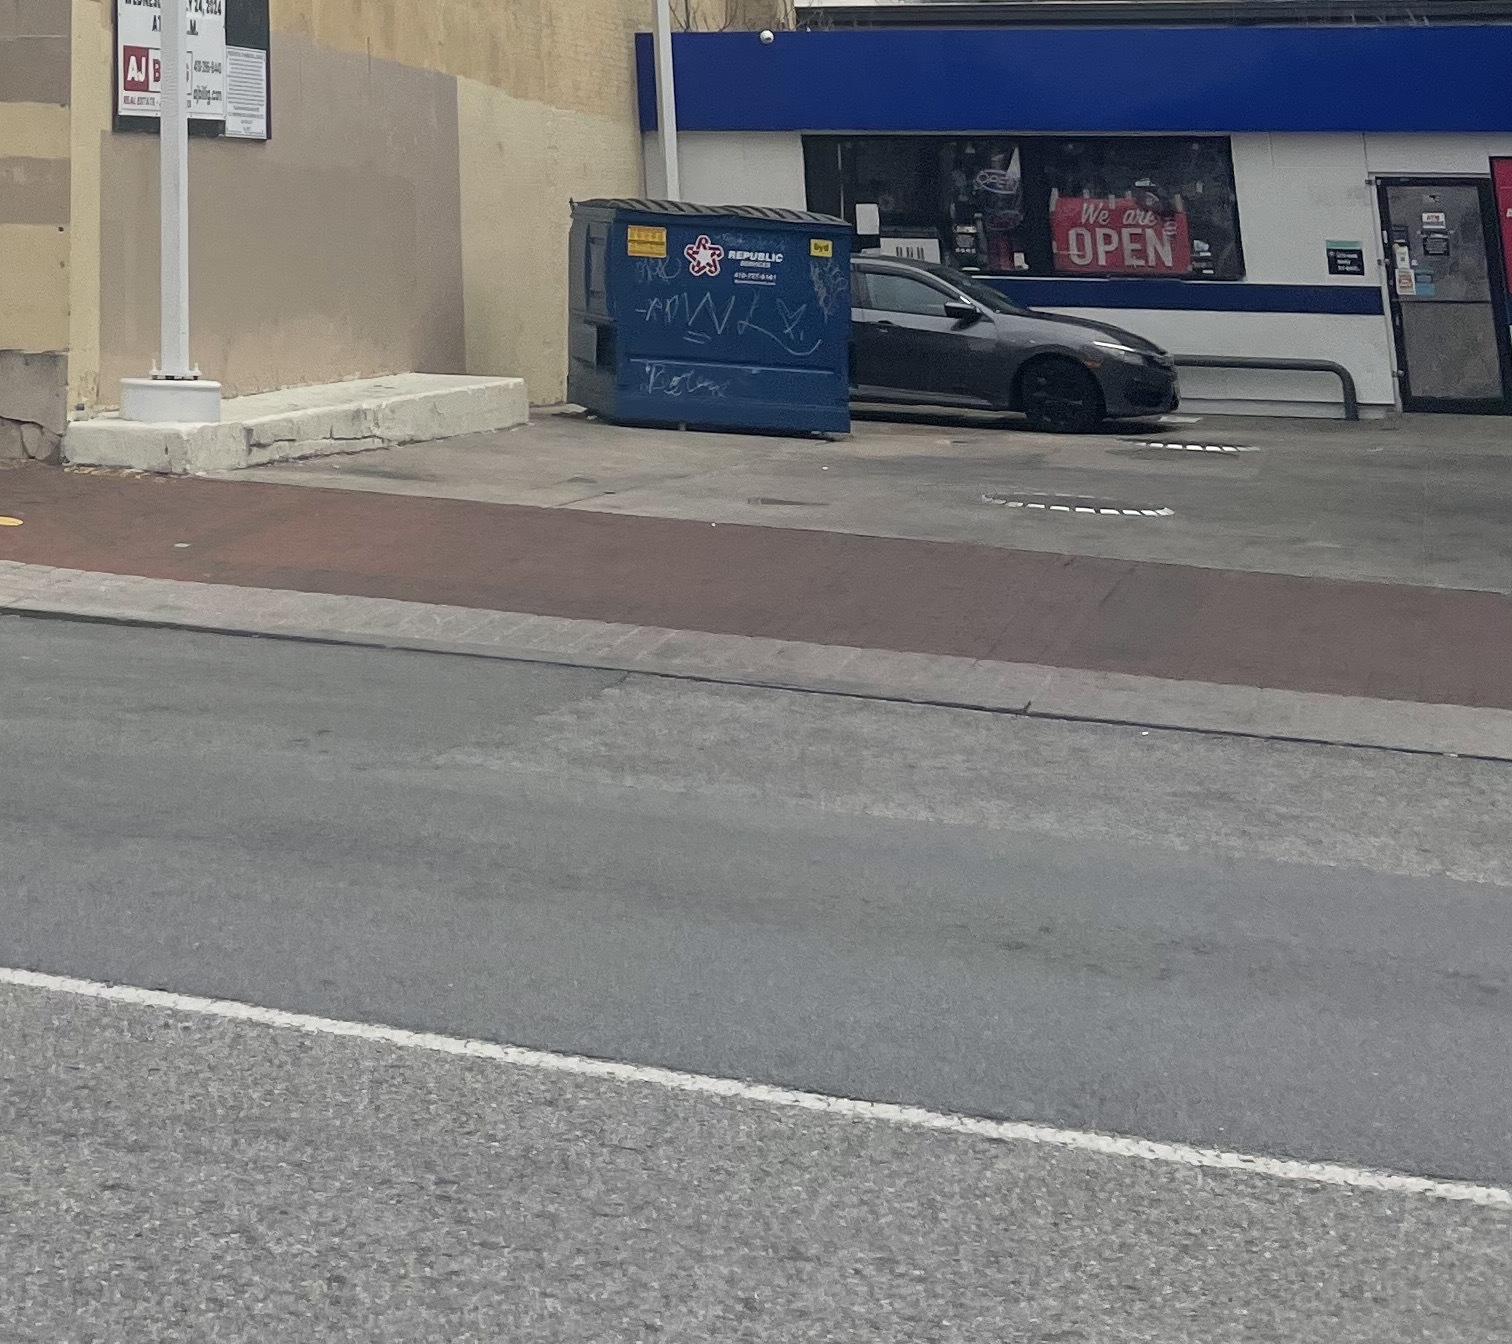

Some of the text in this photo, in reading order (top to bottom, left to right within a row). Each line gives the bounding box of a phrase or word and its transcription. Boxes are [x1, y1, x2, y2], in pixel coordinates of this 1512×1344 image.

[126, 55, 147, 83] AJ
[1081, 202, 1158, 226] We are
[728, 250, 784, 263] REPUBLIC
[1068, 227, 1173, 267] OPEN
